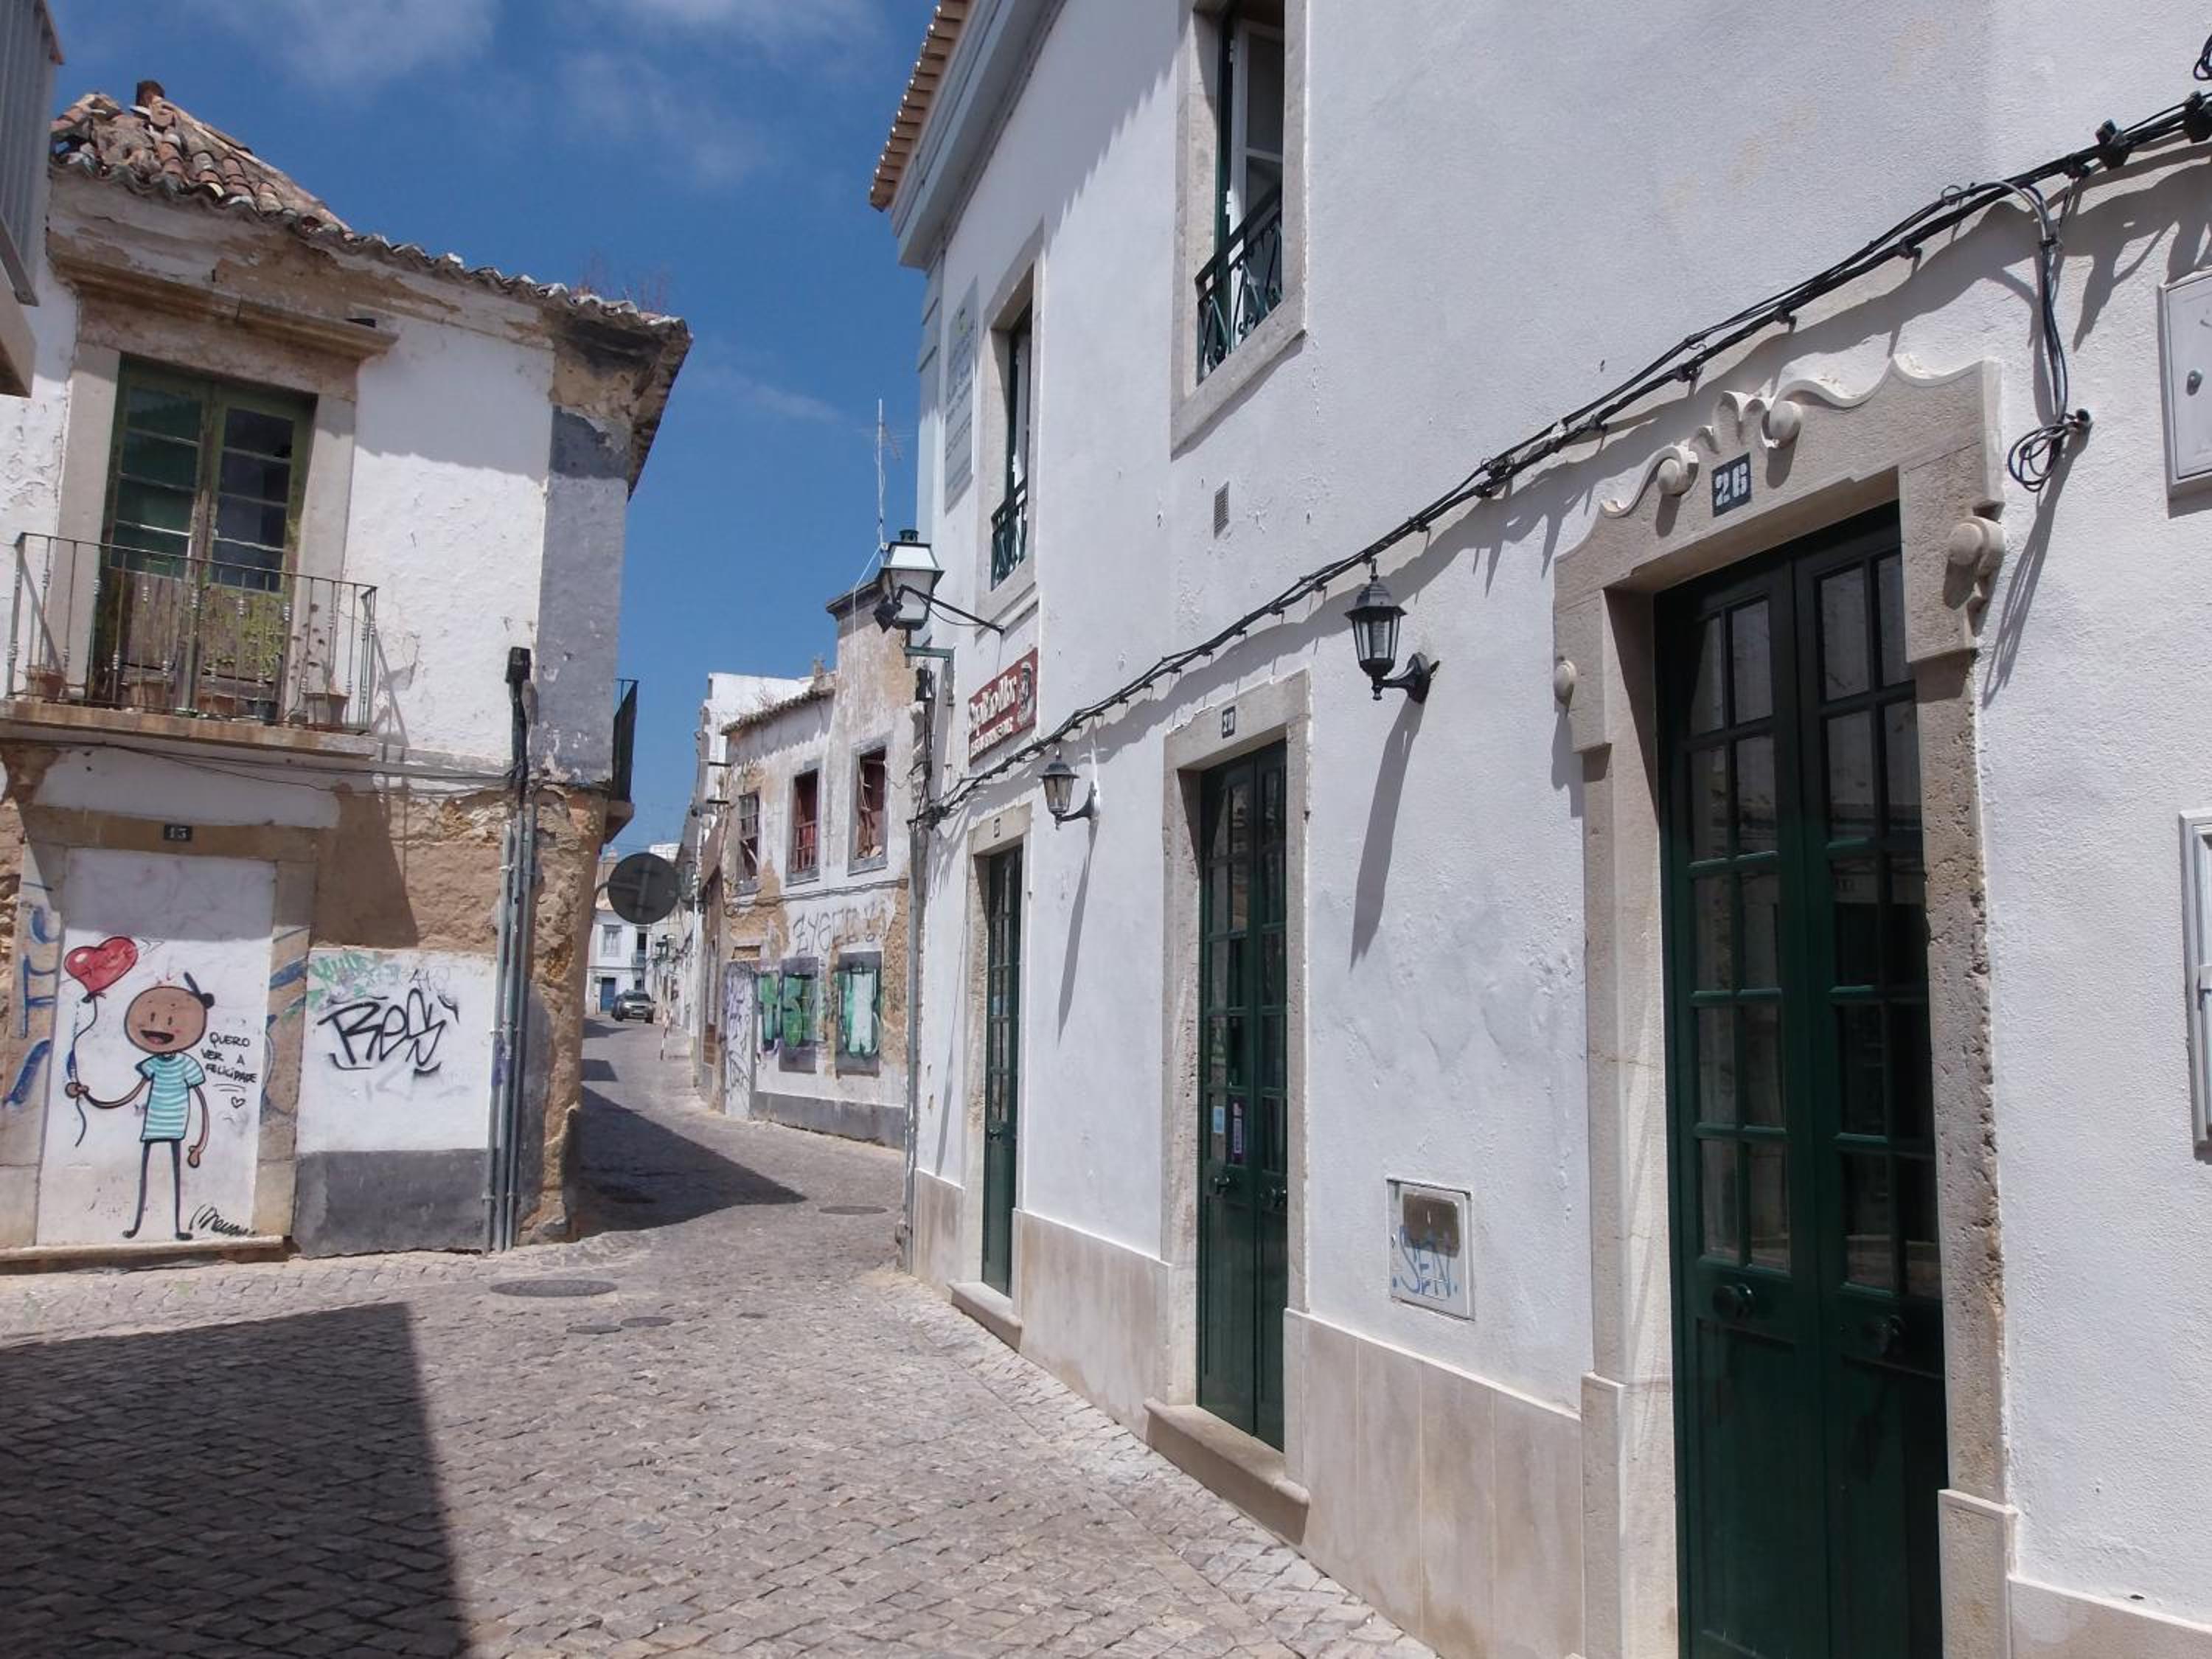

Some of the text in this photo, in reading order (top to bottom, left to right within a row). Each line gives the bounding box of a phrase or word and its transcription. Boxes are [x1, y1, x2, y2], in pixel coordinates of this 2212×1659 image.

[1715, 462, 1747, 507] 26
[209, 1032, 250, 1048] QUERO
[236, 1054, 246, 1065] A
